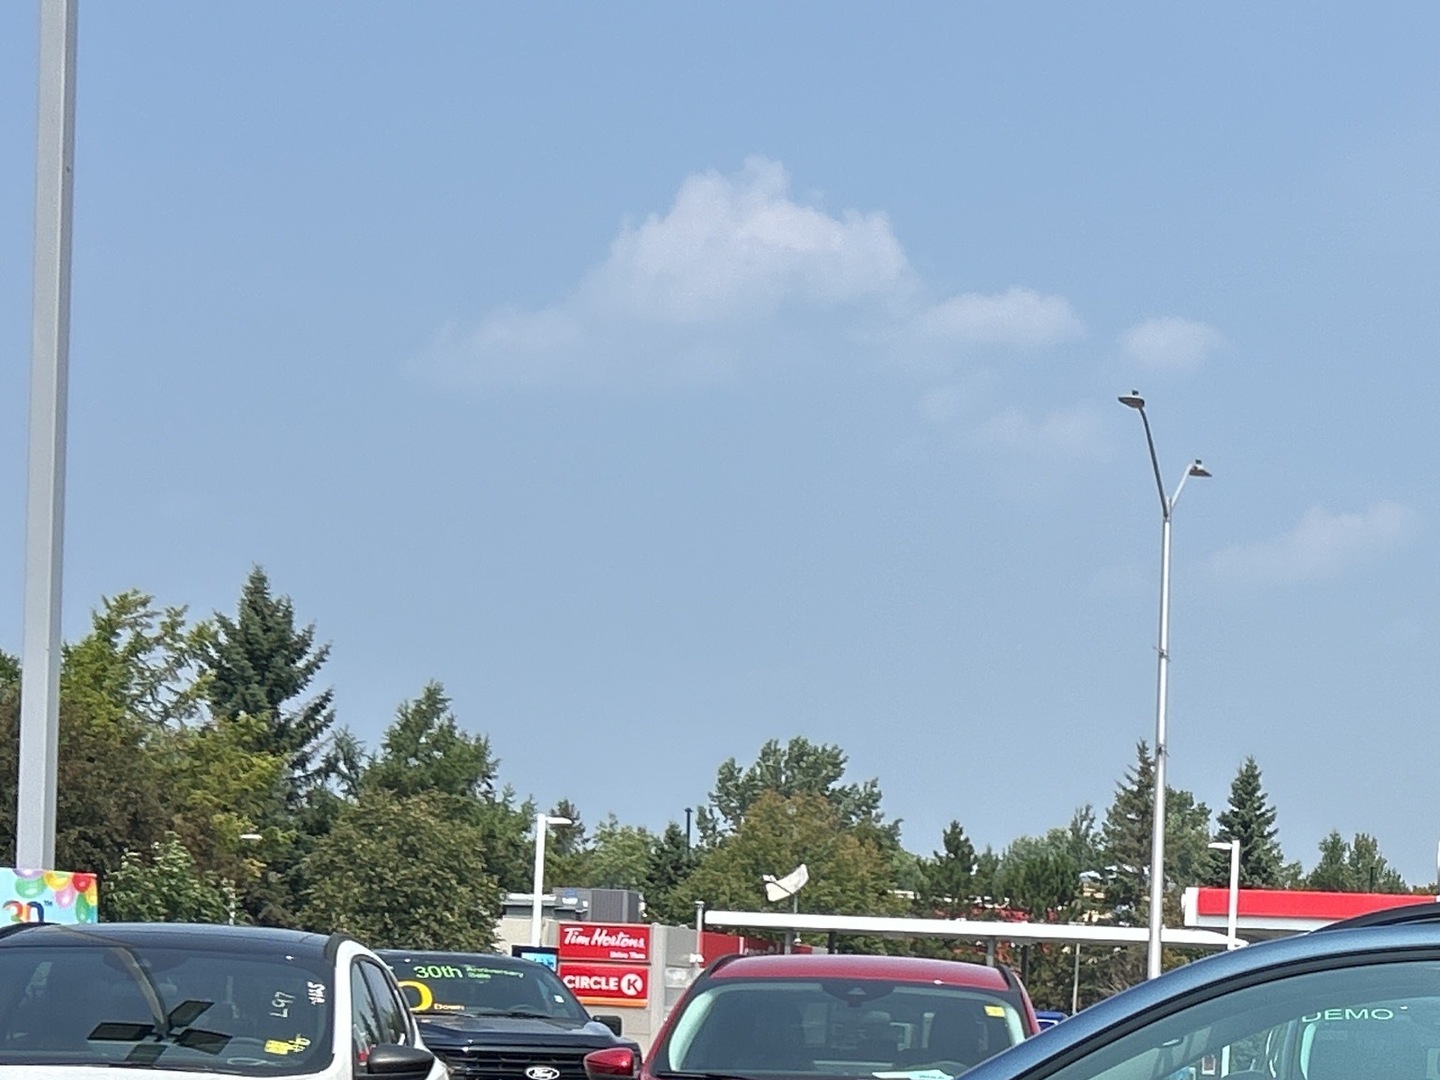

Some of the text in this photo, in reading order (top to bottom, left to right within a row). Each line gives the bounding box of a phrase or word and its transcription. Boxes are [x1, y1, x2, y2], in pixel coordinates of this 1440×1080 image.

[564, 927, 646, 949] Tim Hortons
[413, 965, 463, 979] 30th
[562, 974, 620, 991] CIRCLE
